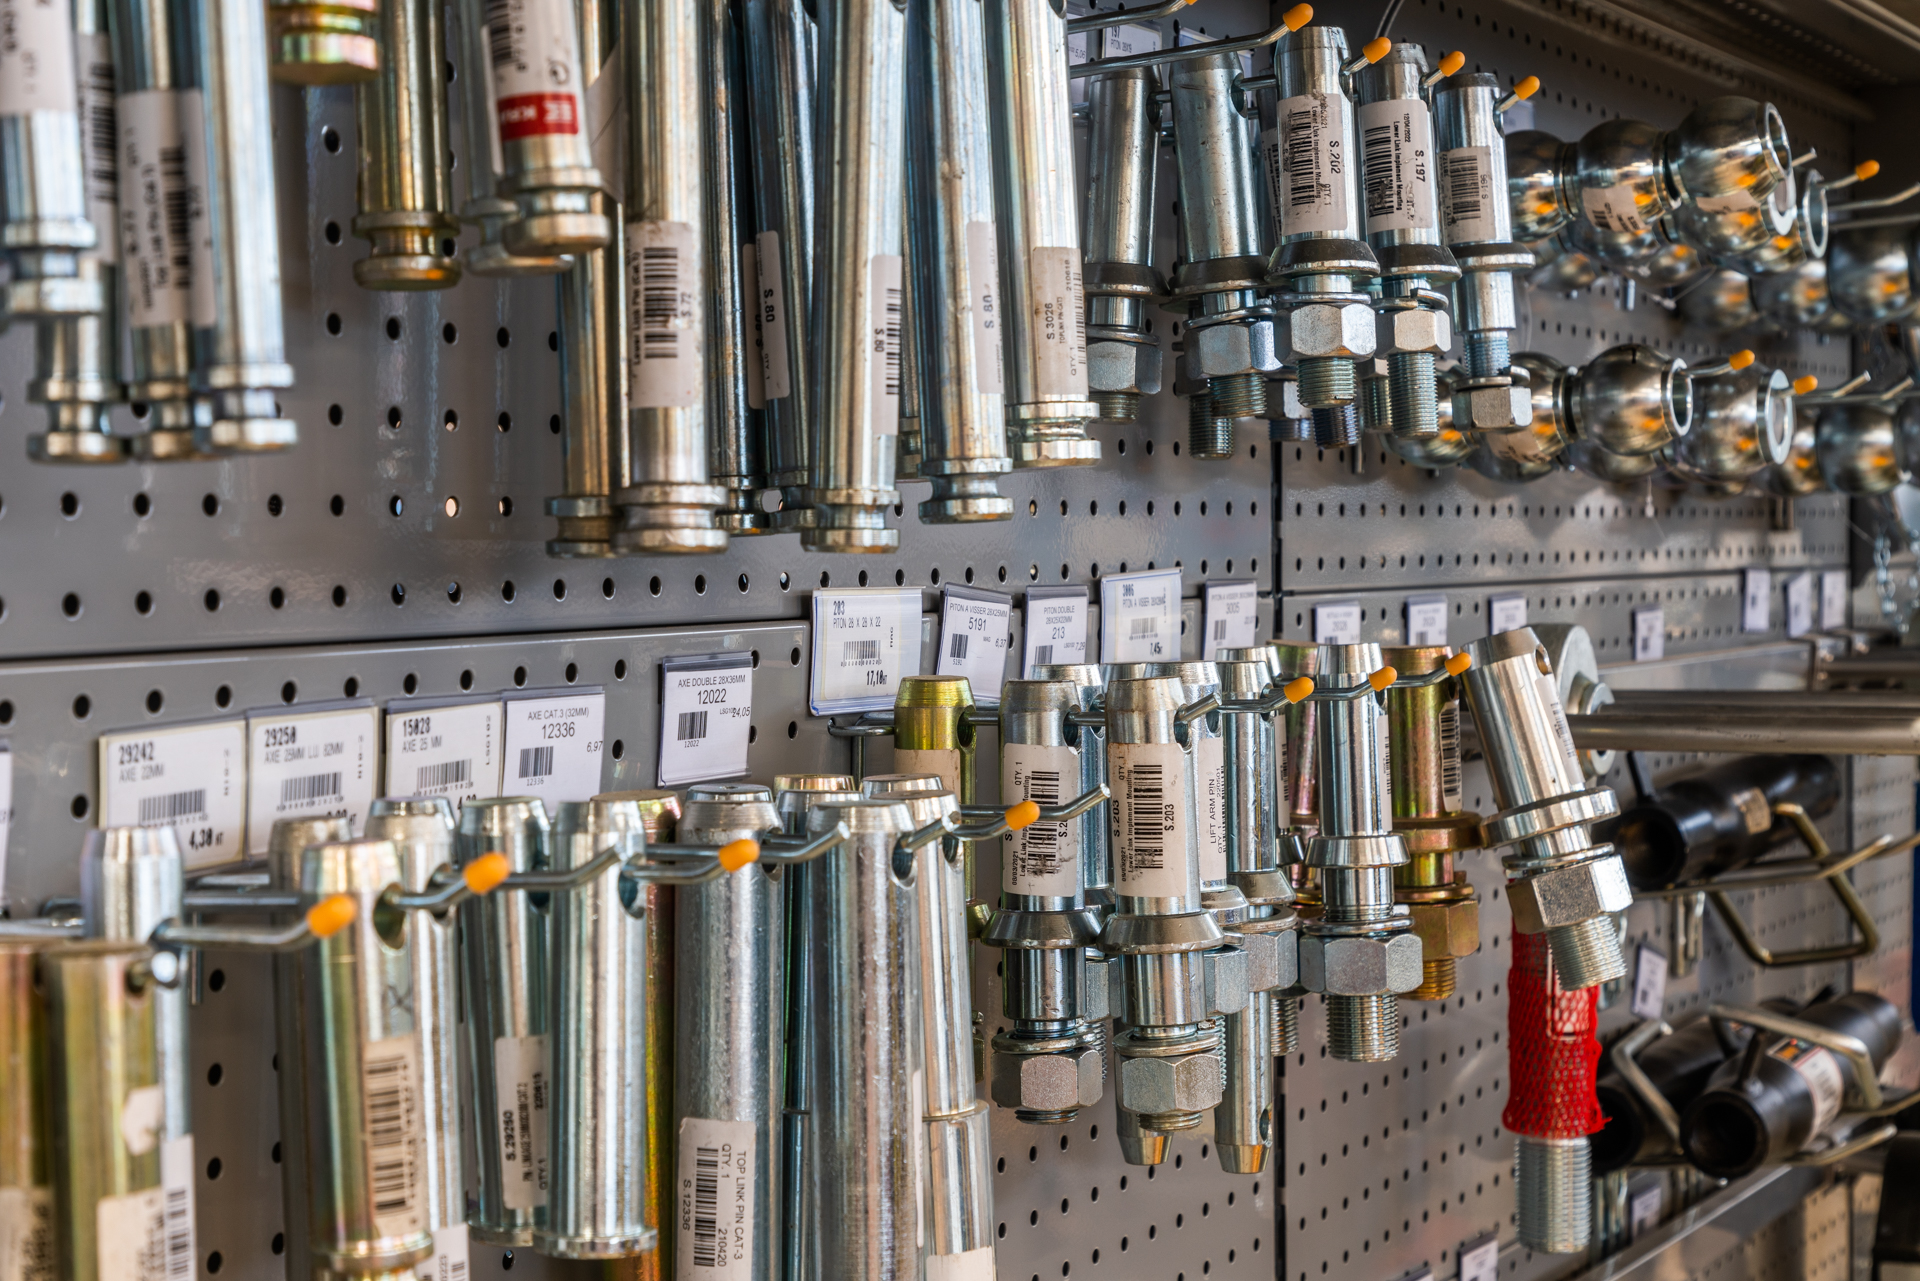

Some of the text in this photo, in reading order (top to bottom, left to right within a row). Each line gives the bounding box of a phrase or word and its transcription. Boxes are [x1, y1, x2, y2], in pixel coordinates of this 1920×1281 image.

[1329, 140, 1341, 175] S.202
[1415, 150, 1426, 183] S.197
[764, 288, 775, 323] S.80
[983, 294, 995, 329] S.80
[1044, 302, 1055, 340] S.3026
[874, 328, 885, 353] S.80
[950, 602, 965, 612] PITON
[970, 606, 987, 615] VISSER
[1044, 605, 1075, 615] PITON DOUBLE
[833, 618, 847, 629] PITON
[968, 617, 987, 632] 5191
[1052, 626, 1066, 640] 213
[678, 678, 691, 688] AXE
[692, 676, 717, 687] DOUBLE
[697, 688, 727, 705] 12022
[528, 707, 589, 721] AXE CAT.3 (32MM)
[542, 721, 575, 740] 12336
[119, 741, 154, 765] 29242
[402, 735, 442, 754] AXE 25 MM
[586, 740, 603, 754] 6,97
[684, 740, 699, 748] 12022
[264, 749, 280, 764] AXE
[119, 765, 136, 783] AXE
[526, 777, 544, 787] 12336
[1015, 766, 1023, 786] QTY.
[1126, 769, 1134, 800] Mounting
[1112, 800, 1120, 837] S.203
[1127, 801, 1135, 836] Implement
[1164, 803, 1175, 831] S.203
[1011, 850, 1019, 886] 08/03/2021
[503, 1109, 517, 1162] S.29250
[721, 1143, 732, 1170] QTY.
[682, 1179, 692, 1231] S.12336
[733, 1150, 747, 1260] TOP LINK PIN CAT-3
[717, 1227, 728, 1267] 210420
